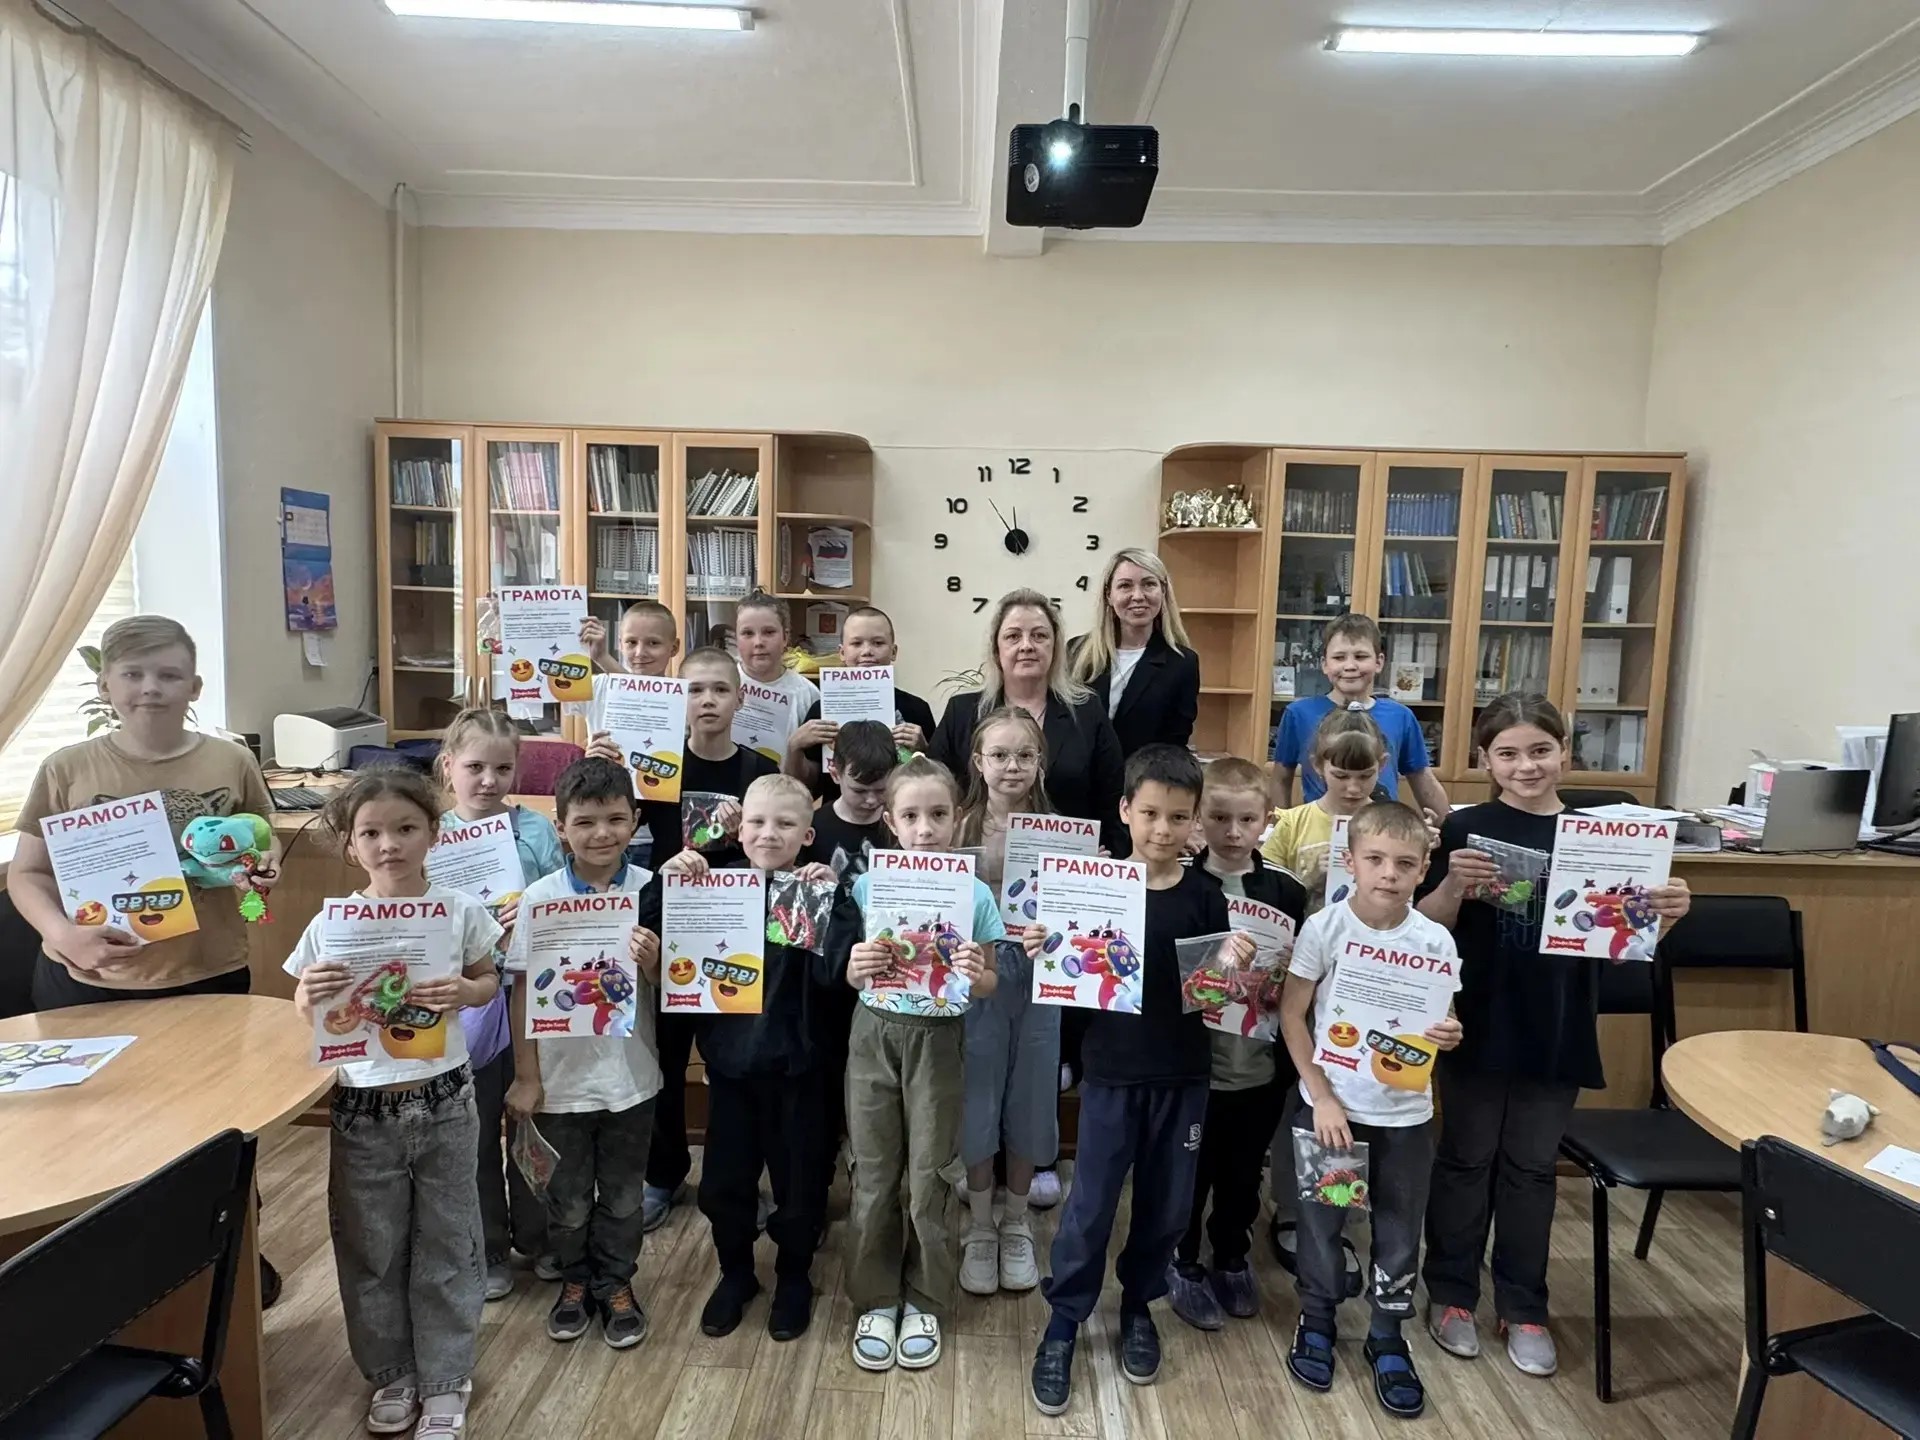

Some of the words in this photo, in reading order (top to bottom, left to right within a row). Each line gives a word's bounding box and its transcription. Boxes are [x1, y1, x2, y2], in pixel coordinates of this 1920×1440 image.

[978, 466, 992, 482] 11
[1008, 458, 1031, 474] 12
[1052, 467, 1060, 483] 1
[946, 498, 968, 514] 10
[1072, 496, 1088, 513] 2
[934, 533, 948, 549] 9
[1086, 535, 1099, 550] 3
[947, 576, 961, 592] 8
[1076, 576, 1089, 591] 4
[501, 589, 582, 602] ГРАМОТА
[973, 598, 988, 613] 7
[823, 669, 890, 681] ГРАМОТА
[610, 678, 683, 695] ГРАМОТА
[740, 683, 788, 706] АМОТА
[46, 798, 158, 835] ГРАМОТА
[436, 820, 507, 848] АМОТА
[1010, 817, 1095, 836] ГРАМОТА
[1561, 819, 1669, 839] ГРАМОТА
[873, 854, 969, 873] ГРАМОТА
[1043, 858, 1140, 881] ГРАМОТА
[667, 874, 760, 887] ГРАМОТА
[328, 902, 448, 920] ГРАМОТА
[532, 897, 633, 919] ГРАМОТА
[1227, 899, 1290, 931] АМОТА
[1345, 941, 1453, 976] ГРАМОТА
